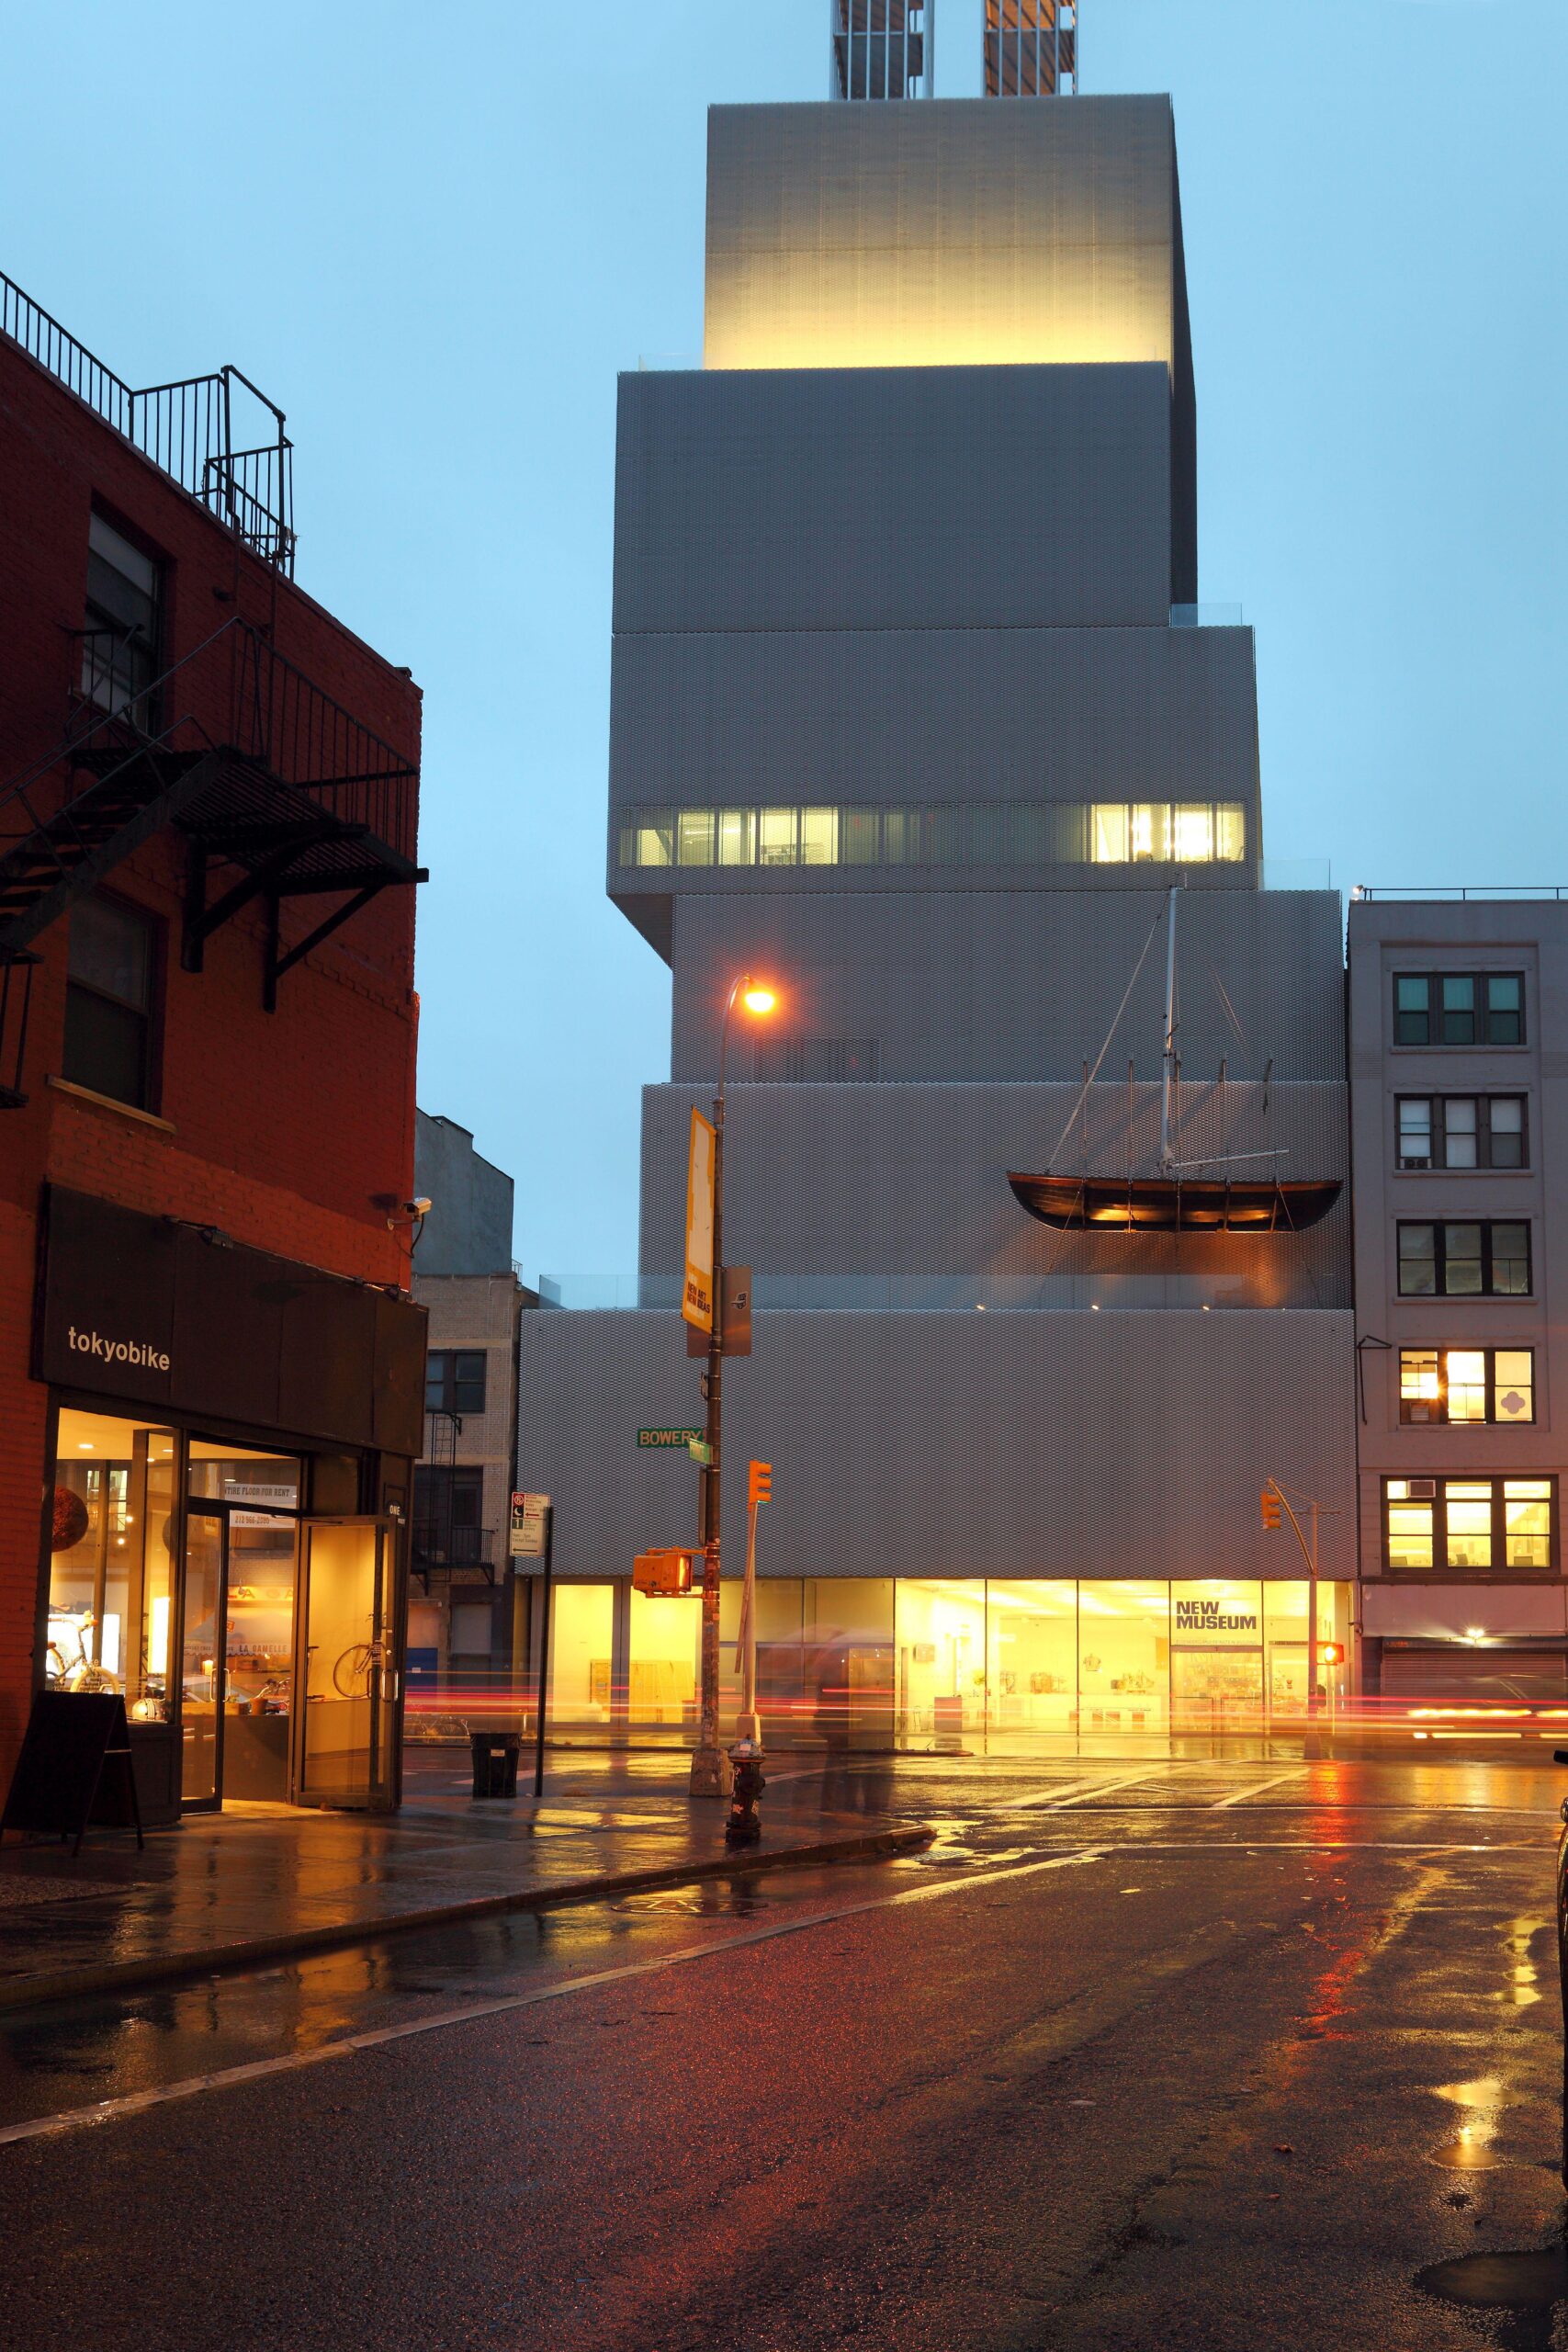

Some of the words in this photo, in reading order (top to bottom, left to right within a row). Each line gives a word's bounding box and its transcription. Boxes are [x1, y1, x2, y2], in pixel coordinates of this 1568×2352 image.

[68, 1326, 170, 1371] tokyobike
[639, 1430, 702, 1445] BOWERY
[274, 1488, 290, 1497] RENT
[1176, 1600, 1220, 1615] NEW
[1176, 1615, 1257, 1630] MUSEUM
